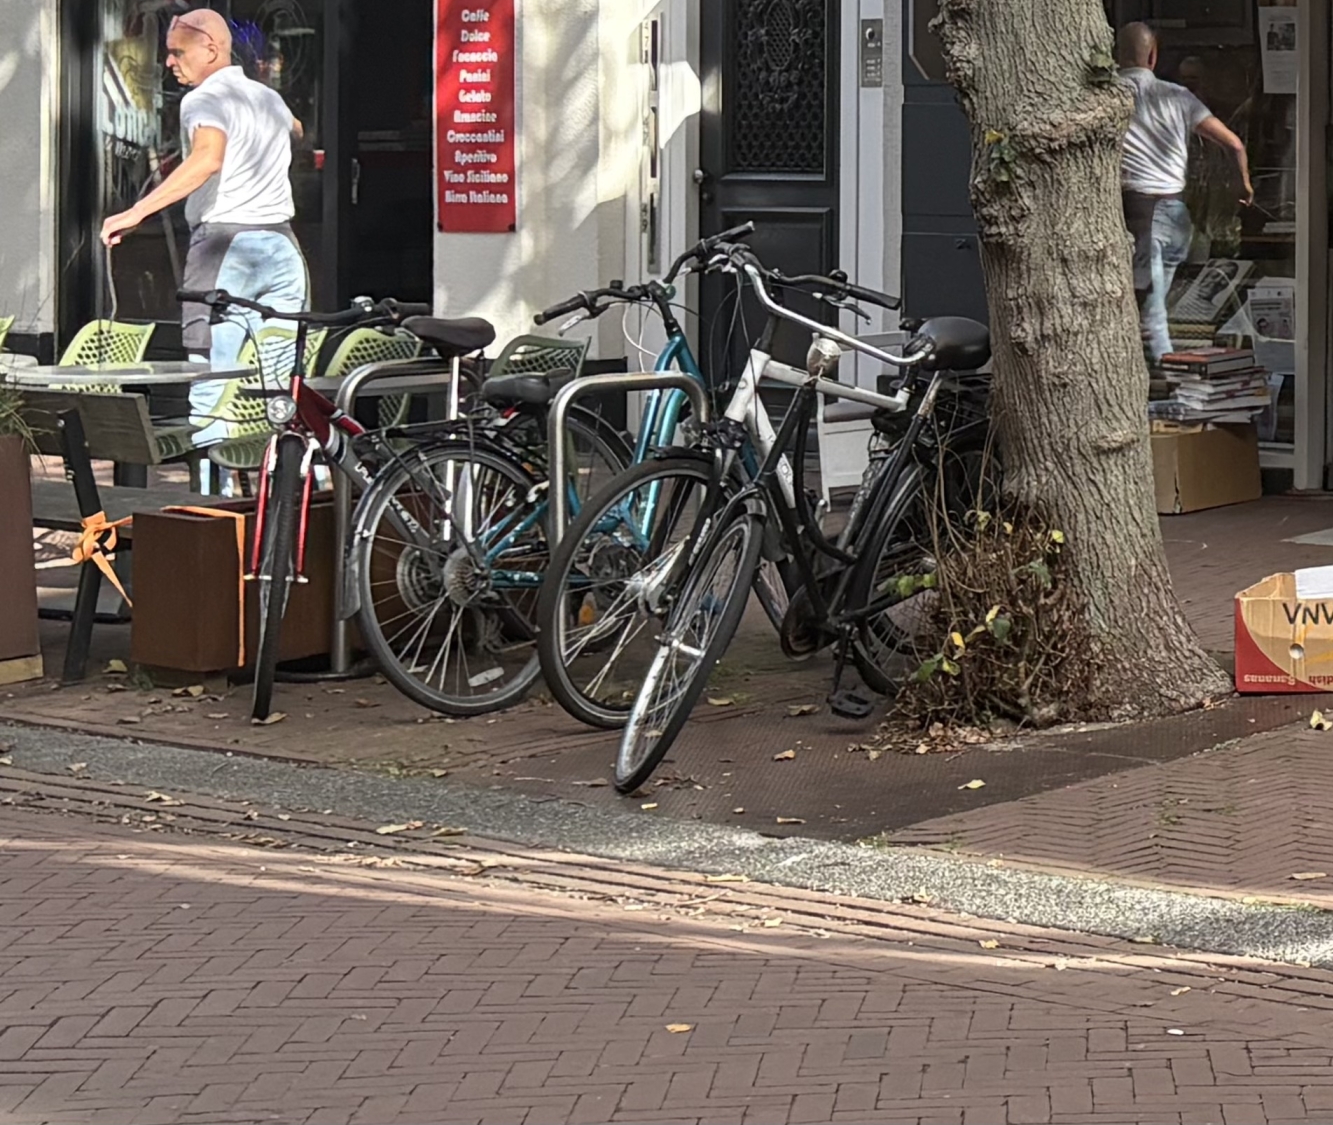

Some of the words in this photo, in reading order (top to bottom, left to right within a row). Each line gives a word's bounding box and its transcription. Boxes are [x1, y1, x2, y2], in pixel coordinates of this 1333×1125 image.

[460, 28, 491, 43] Dolce
[459, 68, 491, 83] Panini
[458, 88, 493, 103] Gelato
[1243, 674, 1297, 686] Bananas
